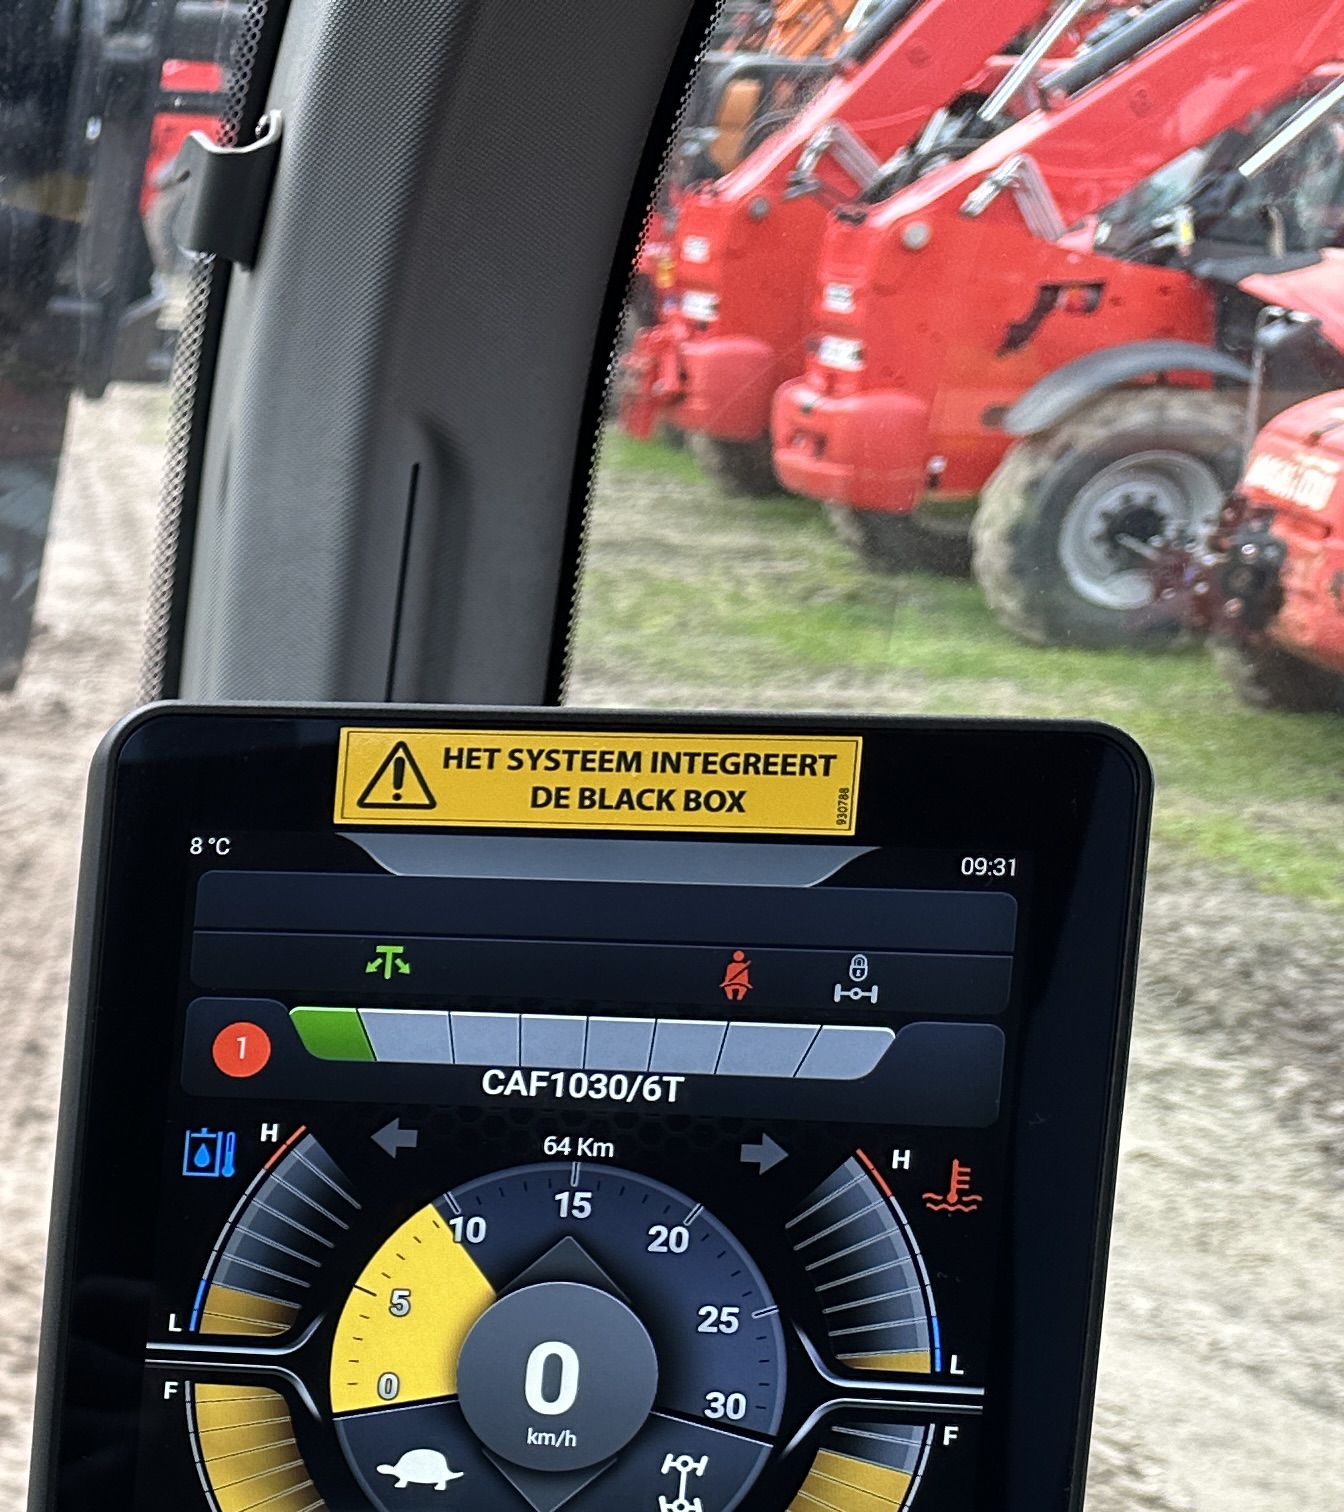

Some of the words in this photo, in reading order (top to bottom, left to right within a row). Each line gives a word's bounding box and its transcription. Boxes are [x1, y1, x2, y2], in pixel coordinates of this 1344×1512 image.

[443, 747, 502, 770] HET
[507, 748, 642, 773] SYSTEEM
[650, 751, 838, 777] INTEGREERT
[530, 786, 571, 809] DE
[577, 787, 675, 812] BLACK
[683, 789, 747, 813] BOX
[836, 787, 849, 825] 930788
[189, 836, 203, 855] 8
[208, 837, 231, 856] °C
[961, 856, 1016, 877] 09:31
[236, 1036, 248, 1060] 1
[482, 1069, 685, 1104] CAF1030/6T
[260, 1123, 280, 1143] H
[543, 1135, 572, 1156] 64
[576, 1137, 614, 1157] Km
[891, 1149, 911, 1170] H
[554, 1191, 592, 1219] 15
[450, 1215, 487, 1246] 10
[647, 1225, 690, 1254] 20
[389, 1288, 411, 1317] 5
[168, 1313, 182, 1332] L
[697, 1305, 740, 1334] 25
[949, 1354, 965, 1375] L
[163, 1381, 179, 1400] F
[377, 1372, 400, 1400] 0
[524, 1341, 580, 1416] 0
[704, 1391, 747, 1420] 30
[526, 1427, 577, 1448] km/h
[942, 1425, 959, 1446] F
